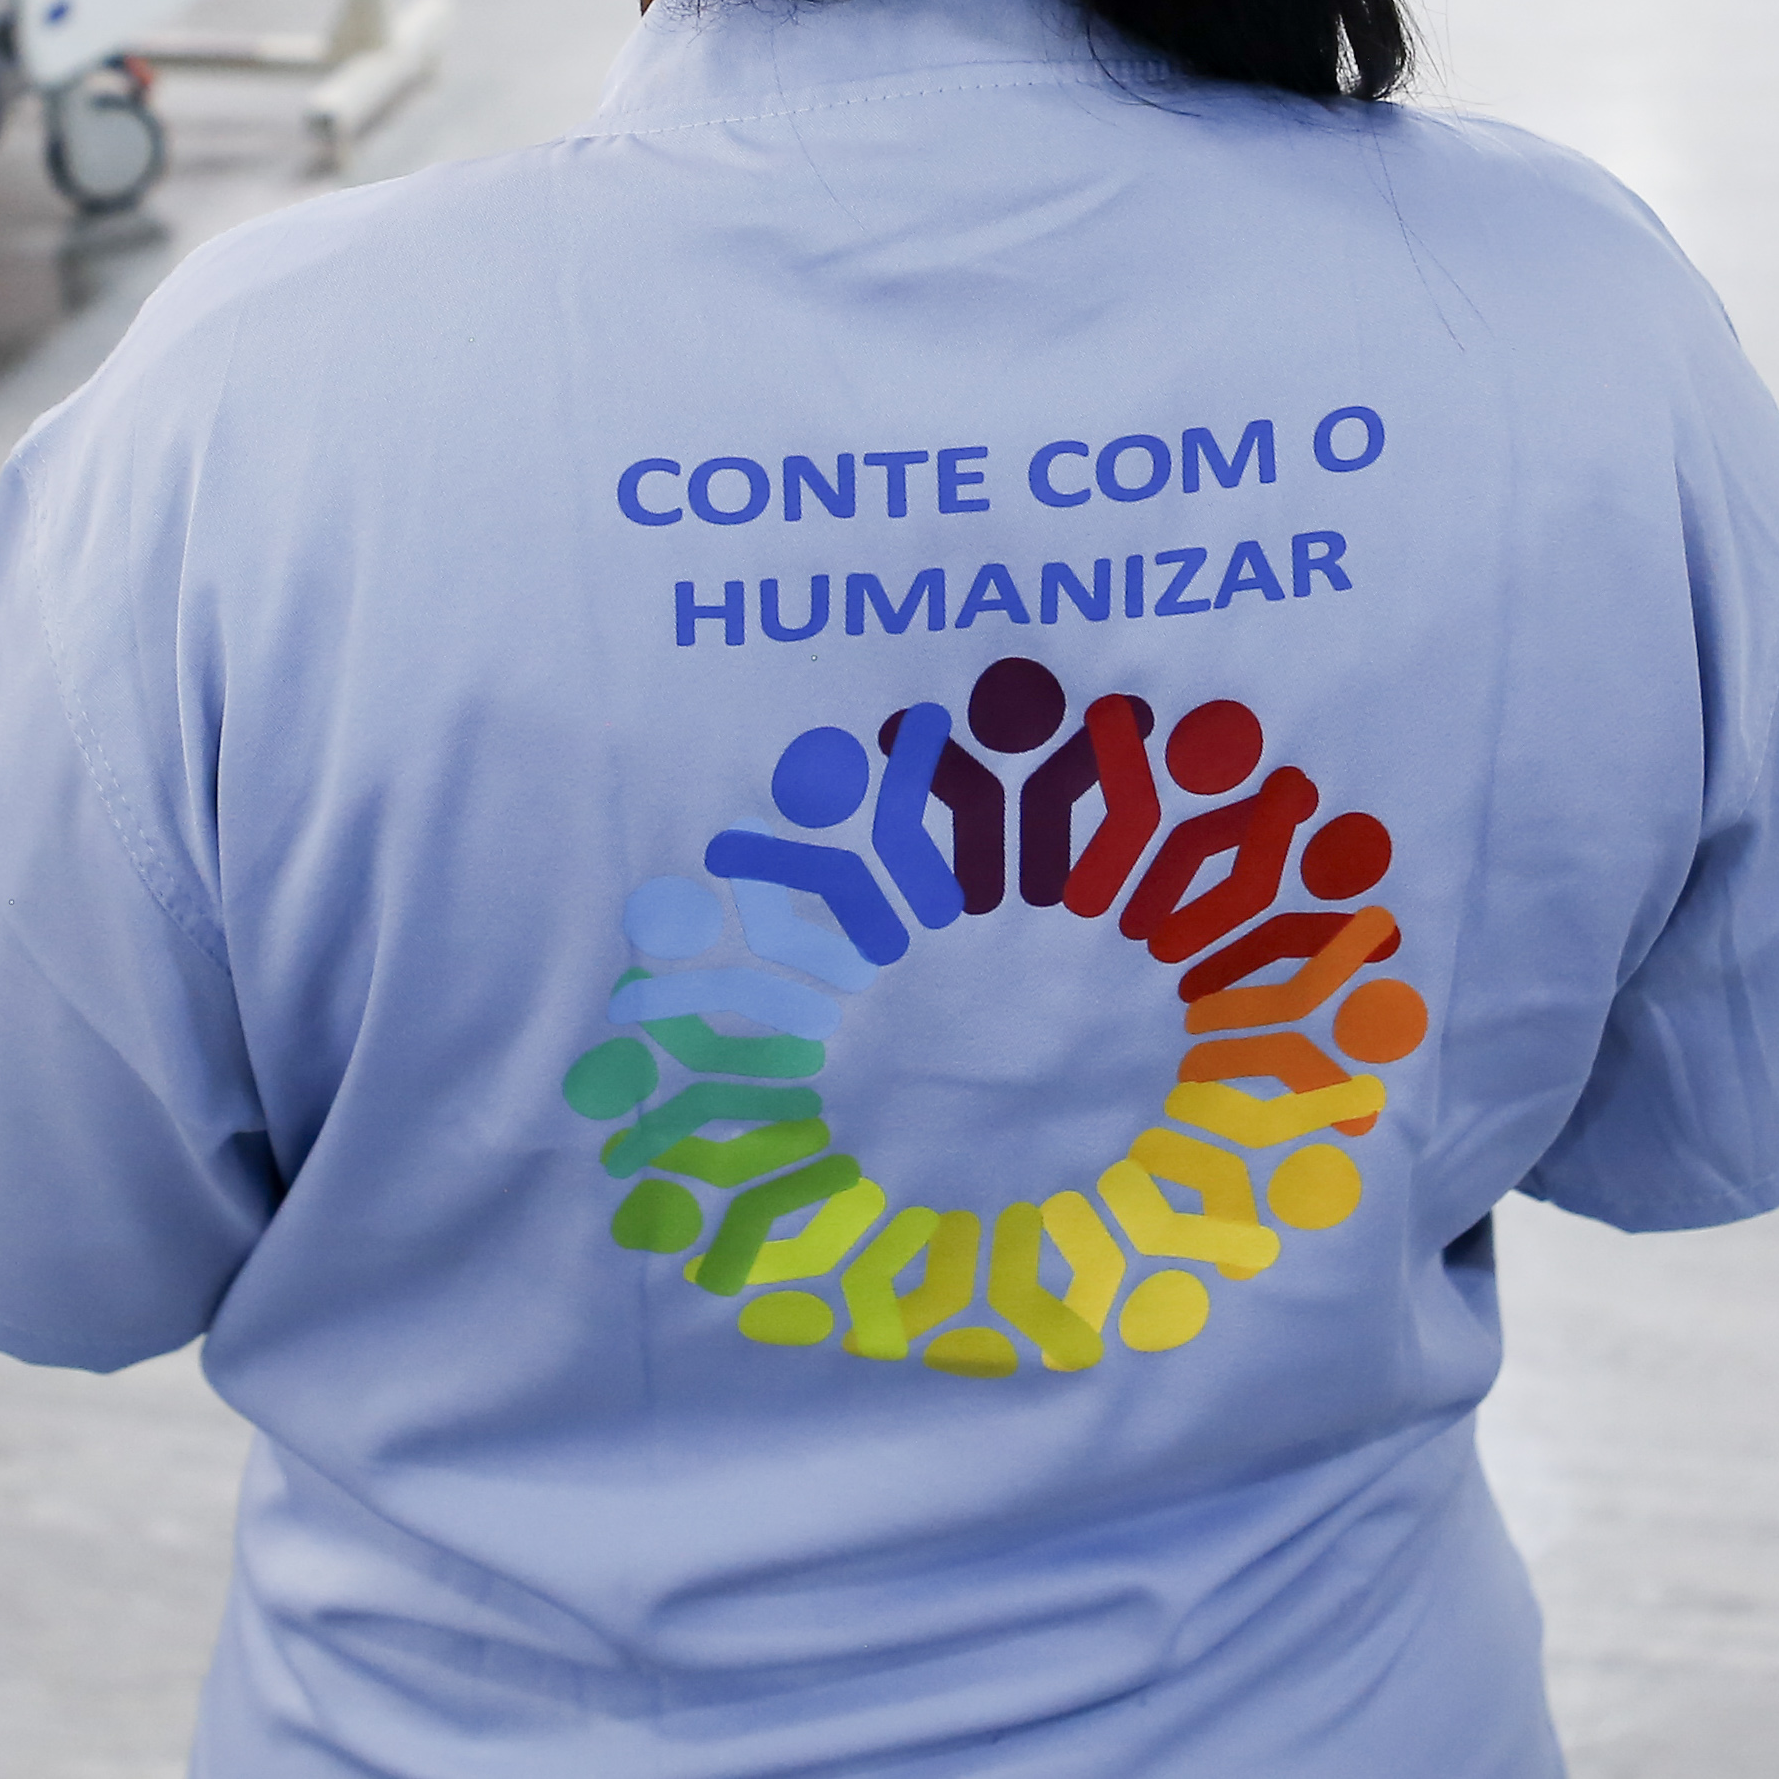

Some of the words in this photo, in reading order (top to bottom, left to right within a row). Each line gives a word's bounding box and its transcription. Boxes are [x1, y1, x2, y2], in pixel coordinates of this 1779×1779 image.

[616, 445, 990, 527] CONTE
[1027, 419, 1278, 509] COM
[1312, 405, 1386, 473] O
[673, 529, 1353, 647] HUMANIZAR
